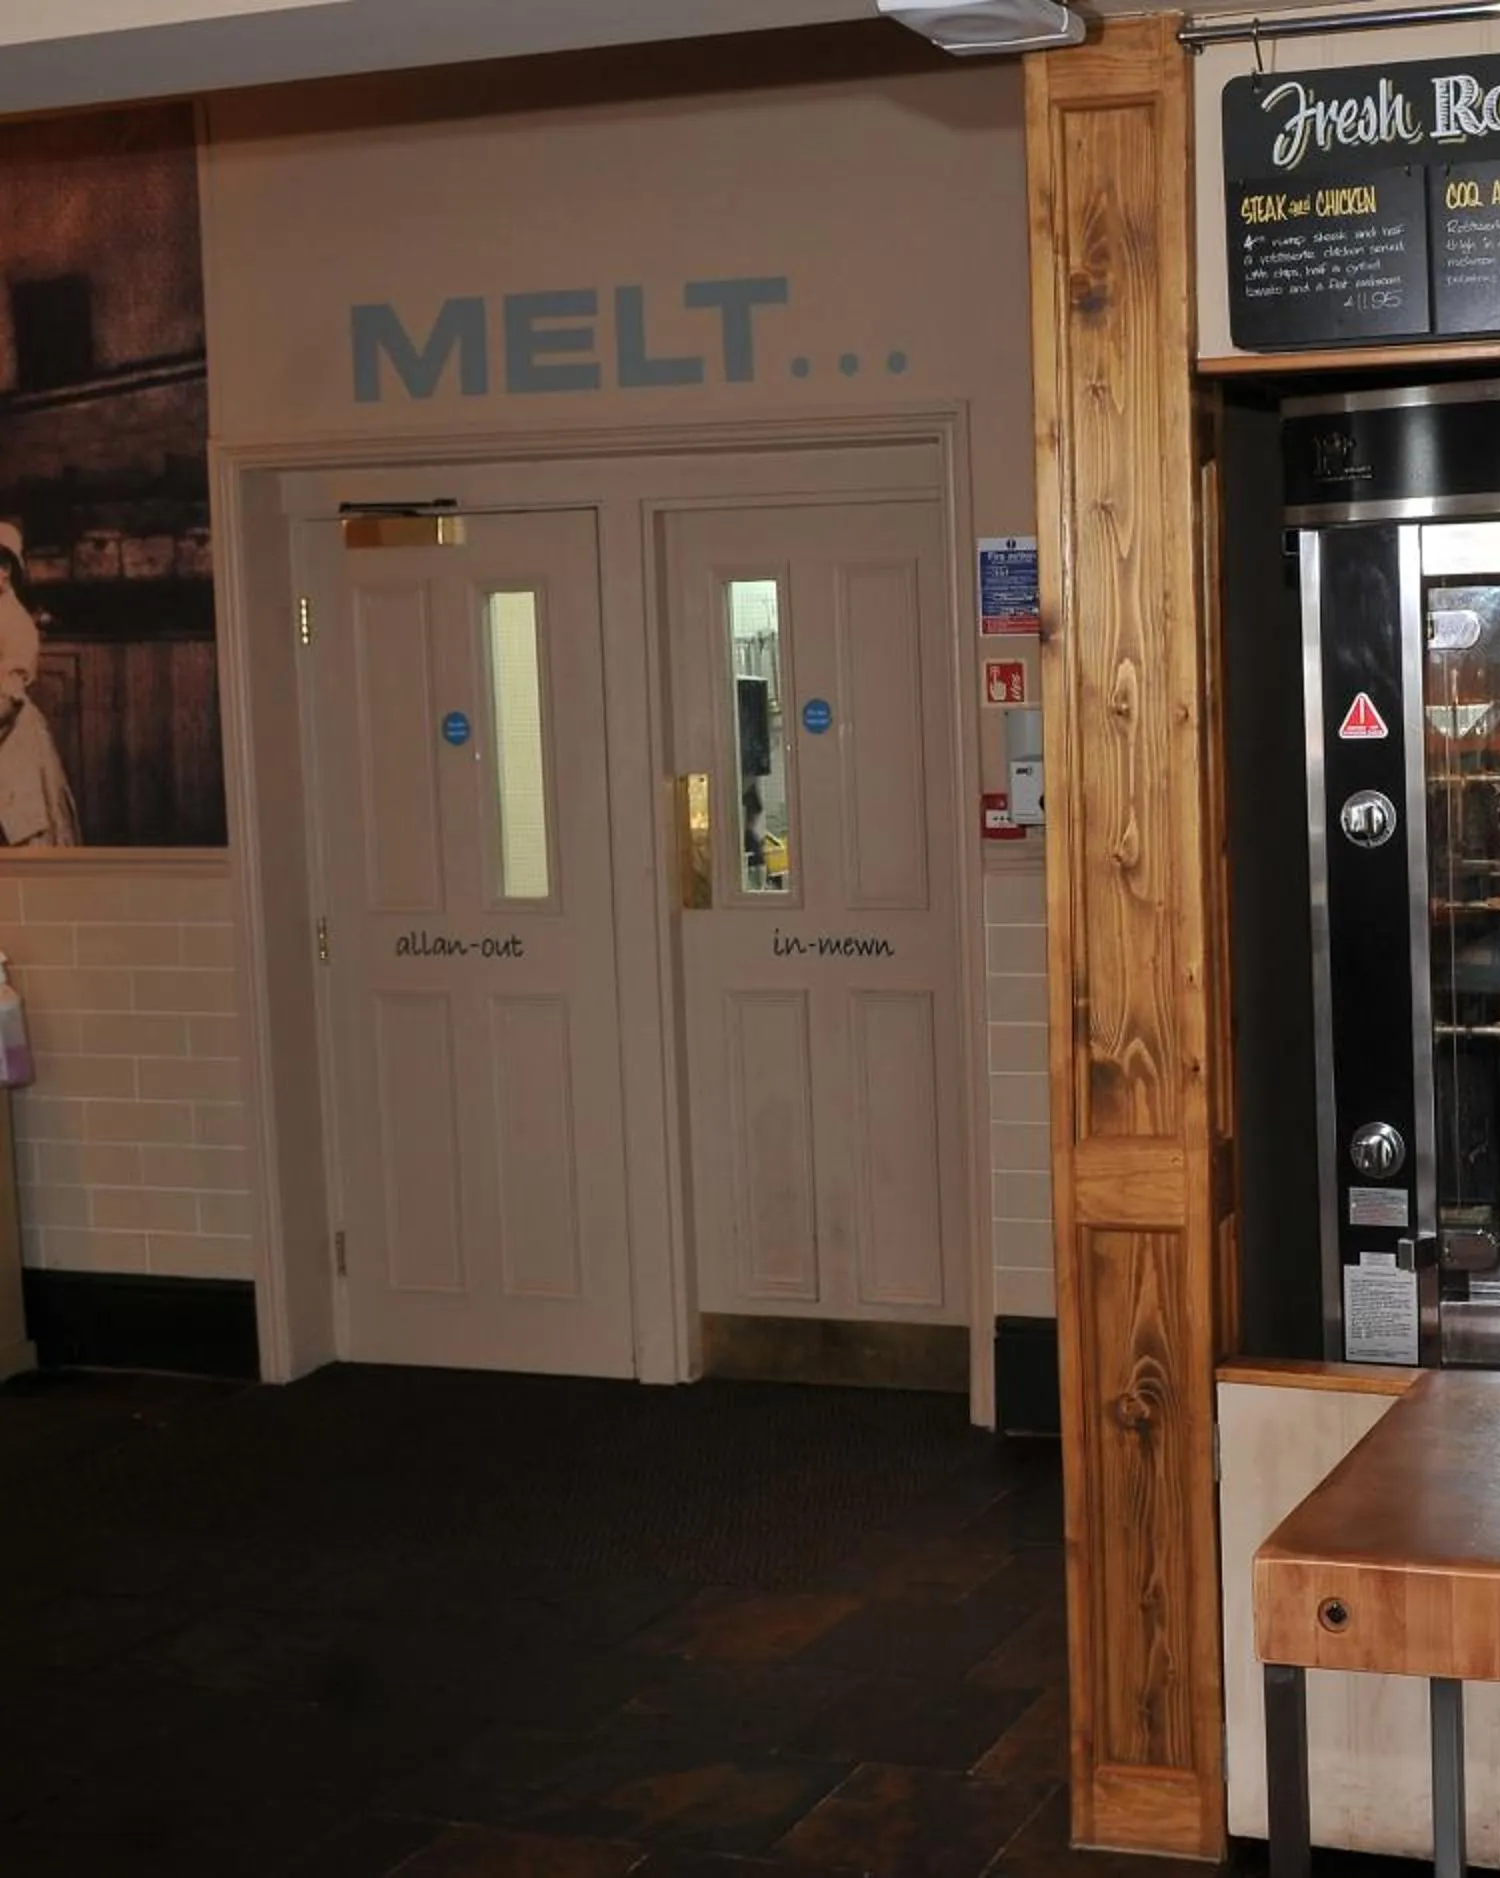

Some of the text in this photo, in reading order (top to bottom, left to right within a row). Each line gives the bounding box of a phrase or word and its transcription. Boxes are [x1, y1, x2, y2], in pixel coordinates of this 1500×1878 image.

[1261, 78, 1422, 170] Fresh
[1241, 185, 1377, 224] STEAK and CHICKEN
[1445, 182, 1484, 209] COQ
[1313, 230, 1346, 244] steak
[1355, 226, 1377, 240] and
[1323, 245, 1365, 259] chicken
[1331, 264, 1341, 274] a
[1289, 280, 1311, 295] and
[1315, 280, 1324, 290] a
[396, 930, 525, 958] allan-out
